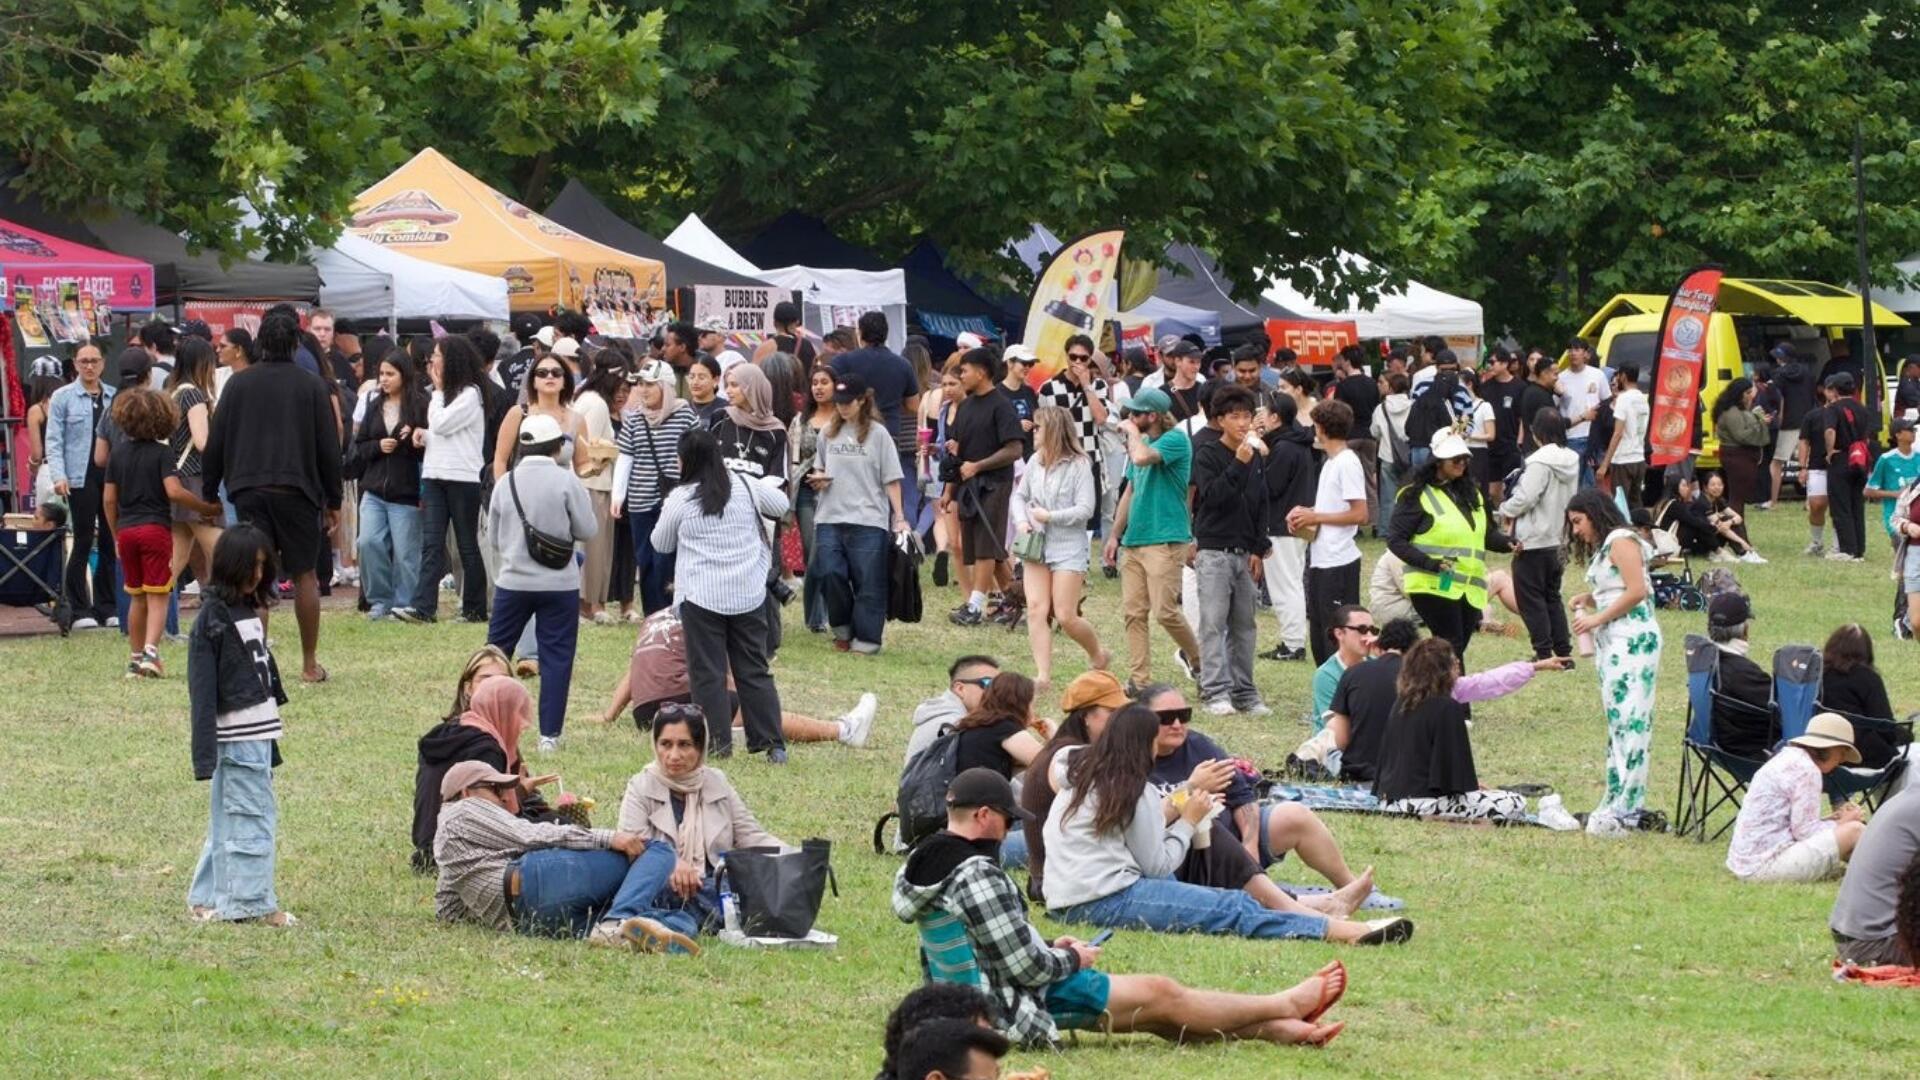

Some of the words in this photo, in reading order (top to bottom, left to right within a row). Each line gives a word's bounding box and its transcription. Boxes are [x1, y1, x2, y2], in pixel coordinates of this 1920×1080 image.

[725, 289, 768, 309] BUBBLES
[728, 311, 735, 330] &
[736, 311, 765, 330] BREW
